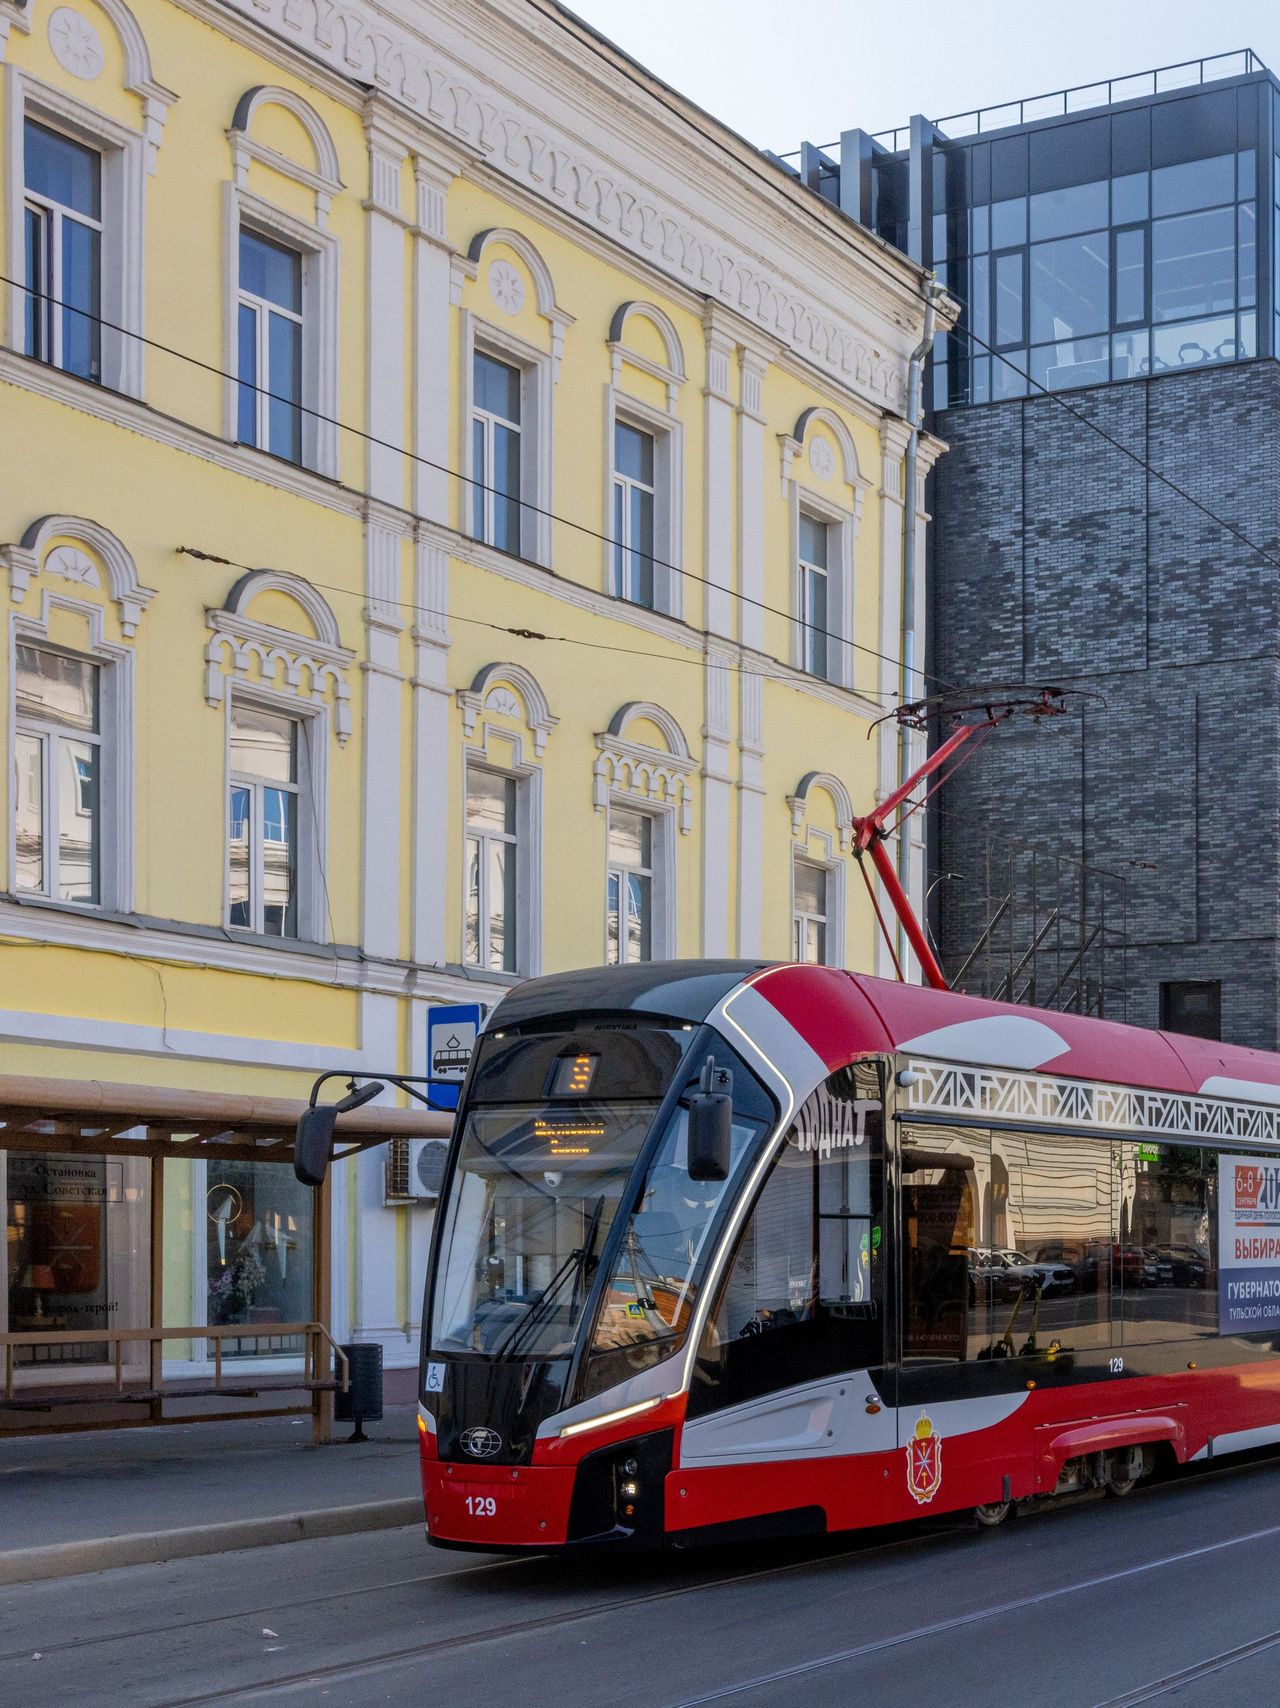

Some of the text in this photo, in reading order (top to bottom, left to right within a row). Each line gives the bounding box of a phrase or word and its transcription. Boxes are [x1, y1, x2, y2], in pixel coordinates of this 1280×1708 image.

[35, 1164, 97, 1178] Остановка
[45, 1182, 107, 1196] Советская
[1236, 1171, 1254, 1192] 6-8
[1236, 1197, 1257, 1206] СЕНТЯБРЯ
[1229, 1304, 1262, 1320] ТУЛЬСКОЙ
[1109, 1357, 1123, 1372] 129
[465, 1496, 496, 1516] 129
